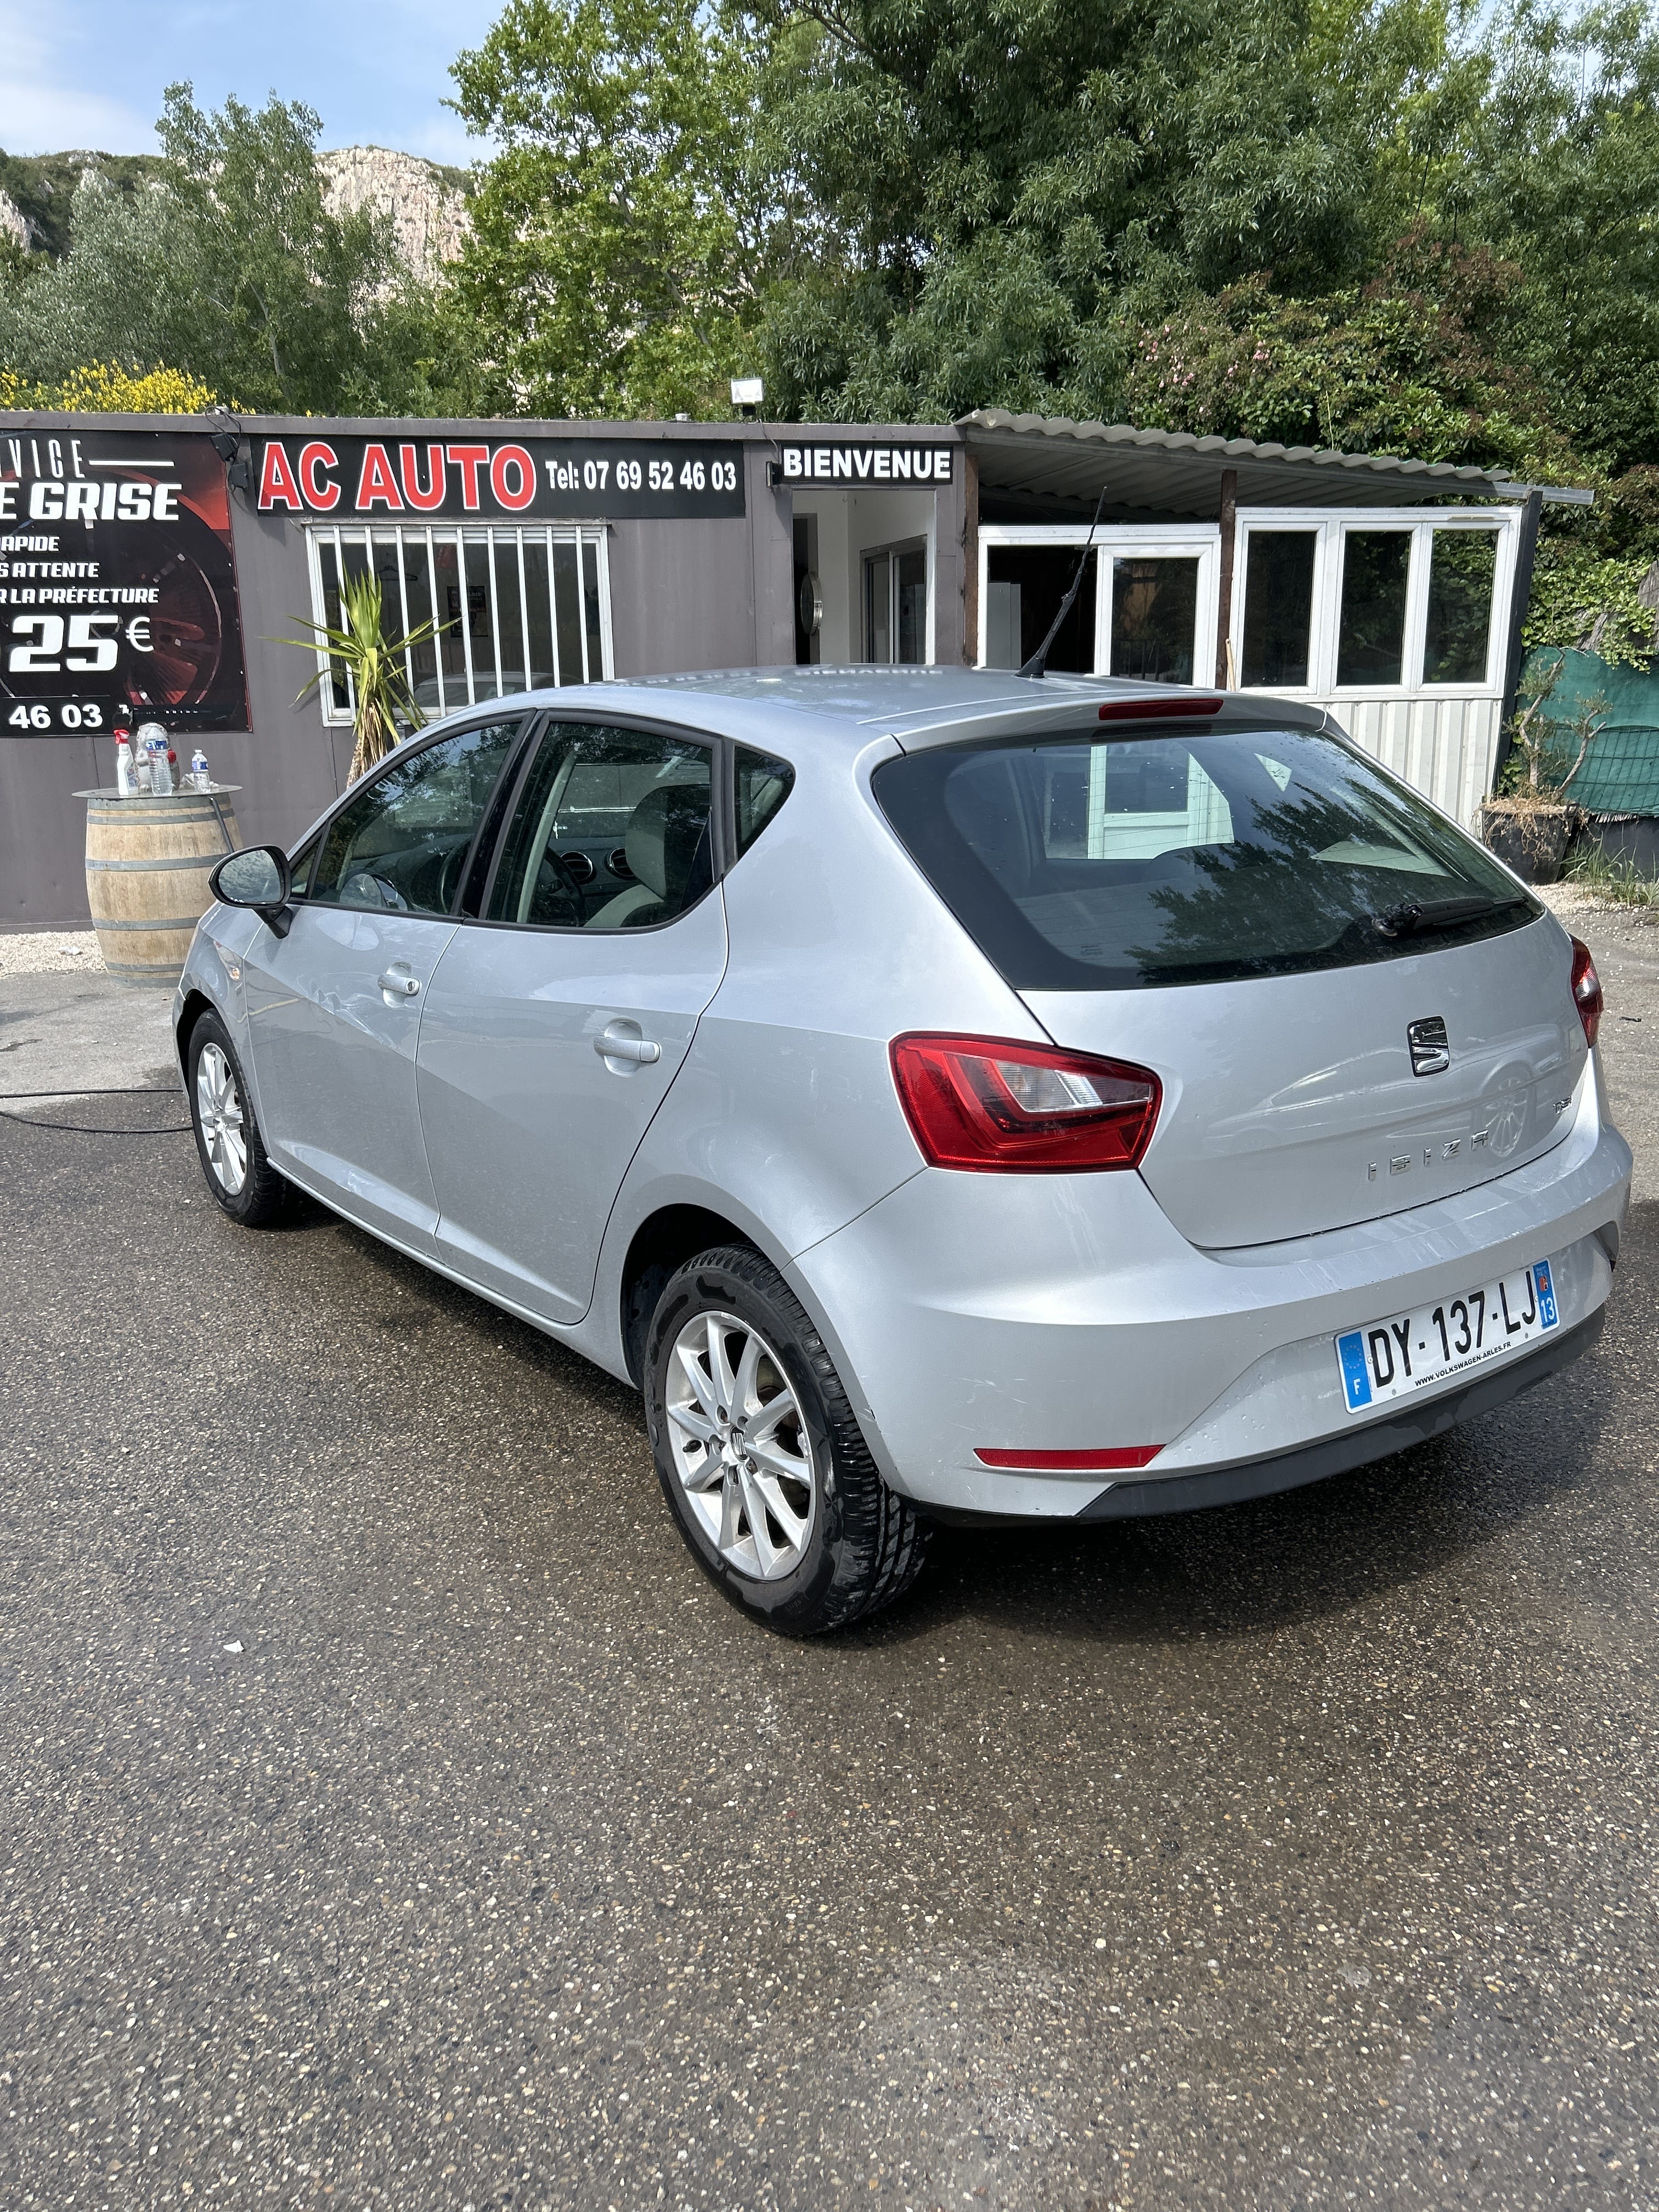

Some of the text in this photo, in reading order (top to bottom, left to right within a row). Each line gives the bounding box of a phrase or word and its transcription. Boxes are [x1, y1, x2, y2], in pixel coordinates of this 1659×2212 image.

[0, 439, 85, 478] VICE
[784, 449, 950, 478] BIENVENUE
[258, 442, 736, 510] AC AUTO Tel: 07 69 52 46 03
[30, 483, 182, 520] GRISE
[0, 536, 60, 551] APIDE
[13, 562, 100, 578] ATTENTE
[11, 589, 35, 603] LA
[39, 585, 160, 603] PRÉFECTURE
[9, 704, 103, 729] 46 03
[1353, 1378, 1361, 1395] F
[1541, 1297, 1555, 1322] 13
[1415, 1341, 1511, 1386] WWW.VOLKSWAGEN-ARLES.FR
